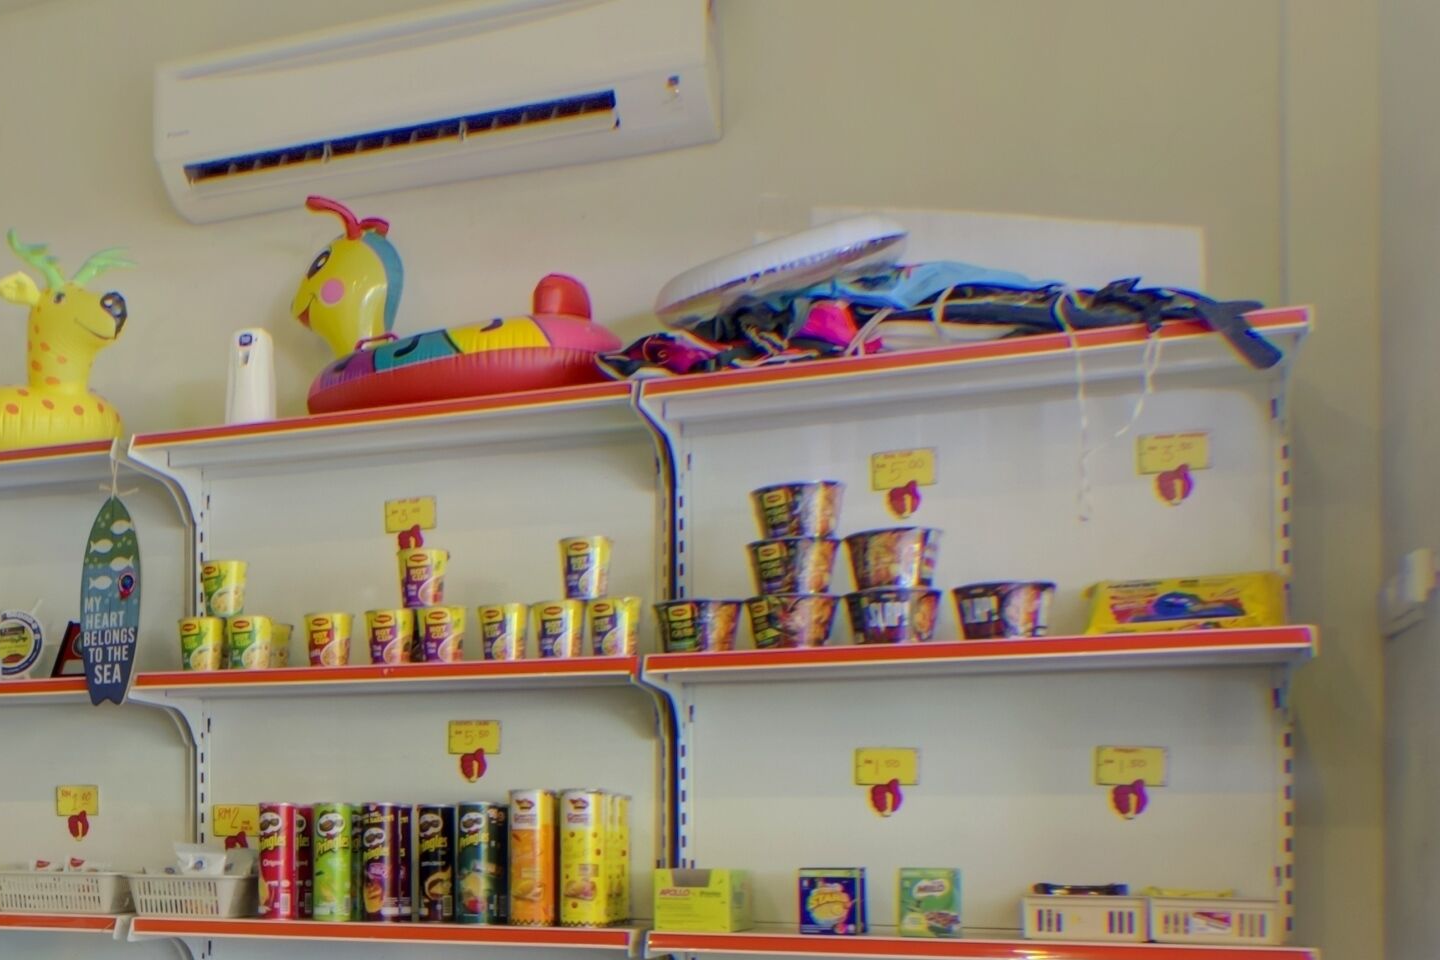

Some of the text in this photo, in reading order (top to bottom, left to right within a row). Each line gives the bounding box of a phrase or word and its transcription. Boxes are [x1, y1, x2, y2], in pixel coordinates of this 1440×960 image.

[84, 596, 102, 613] MY
[85, 611, 125, 630] HEART
[83, 627, 135, 647] BELONGS
[89, 645, 129, 663] TO THE
[94, 663, 122, 684] SEA
[659, 888, 690, 897] APOLLO
